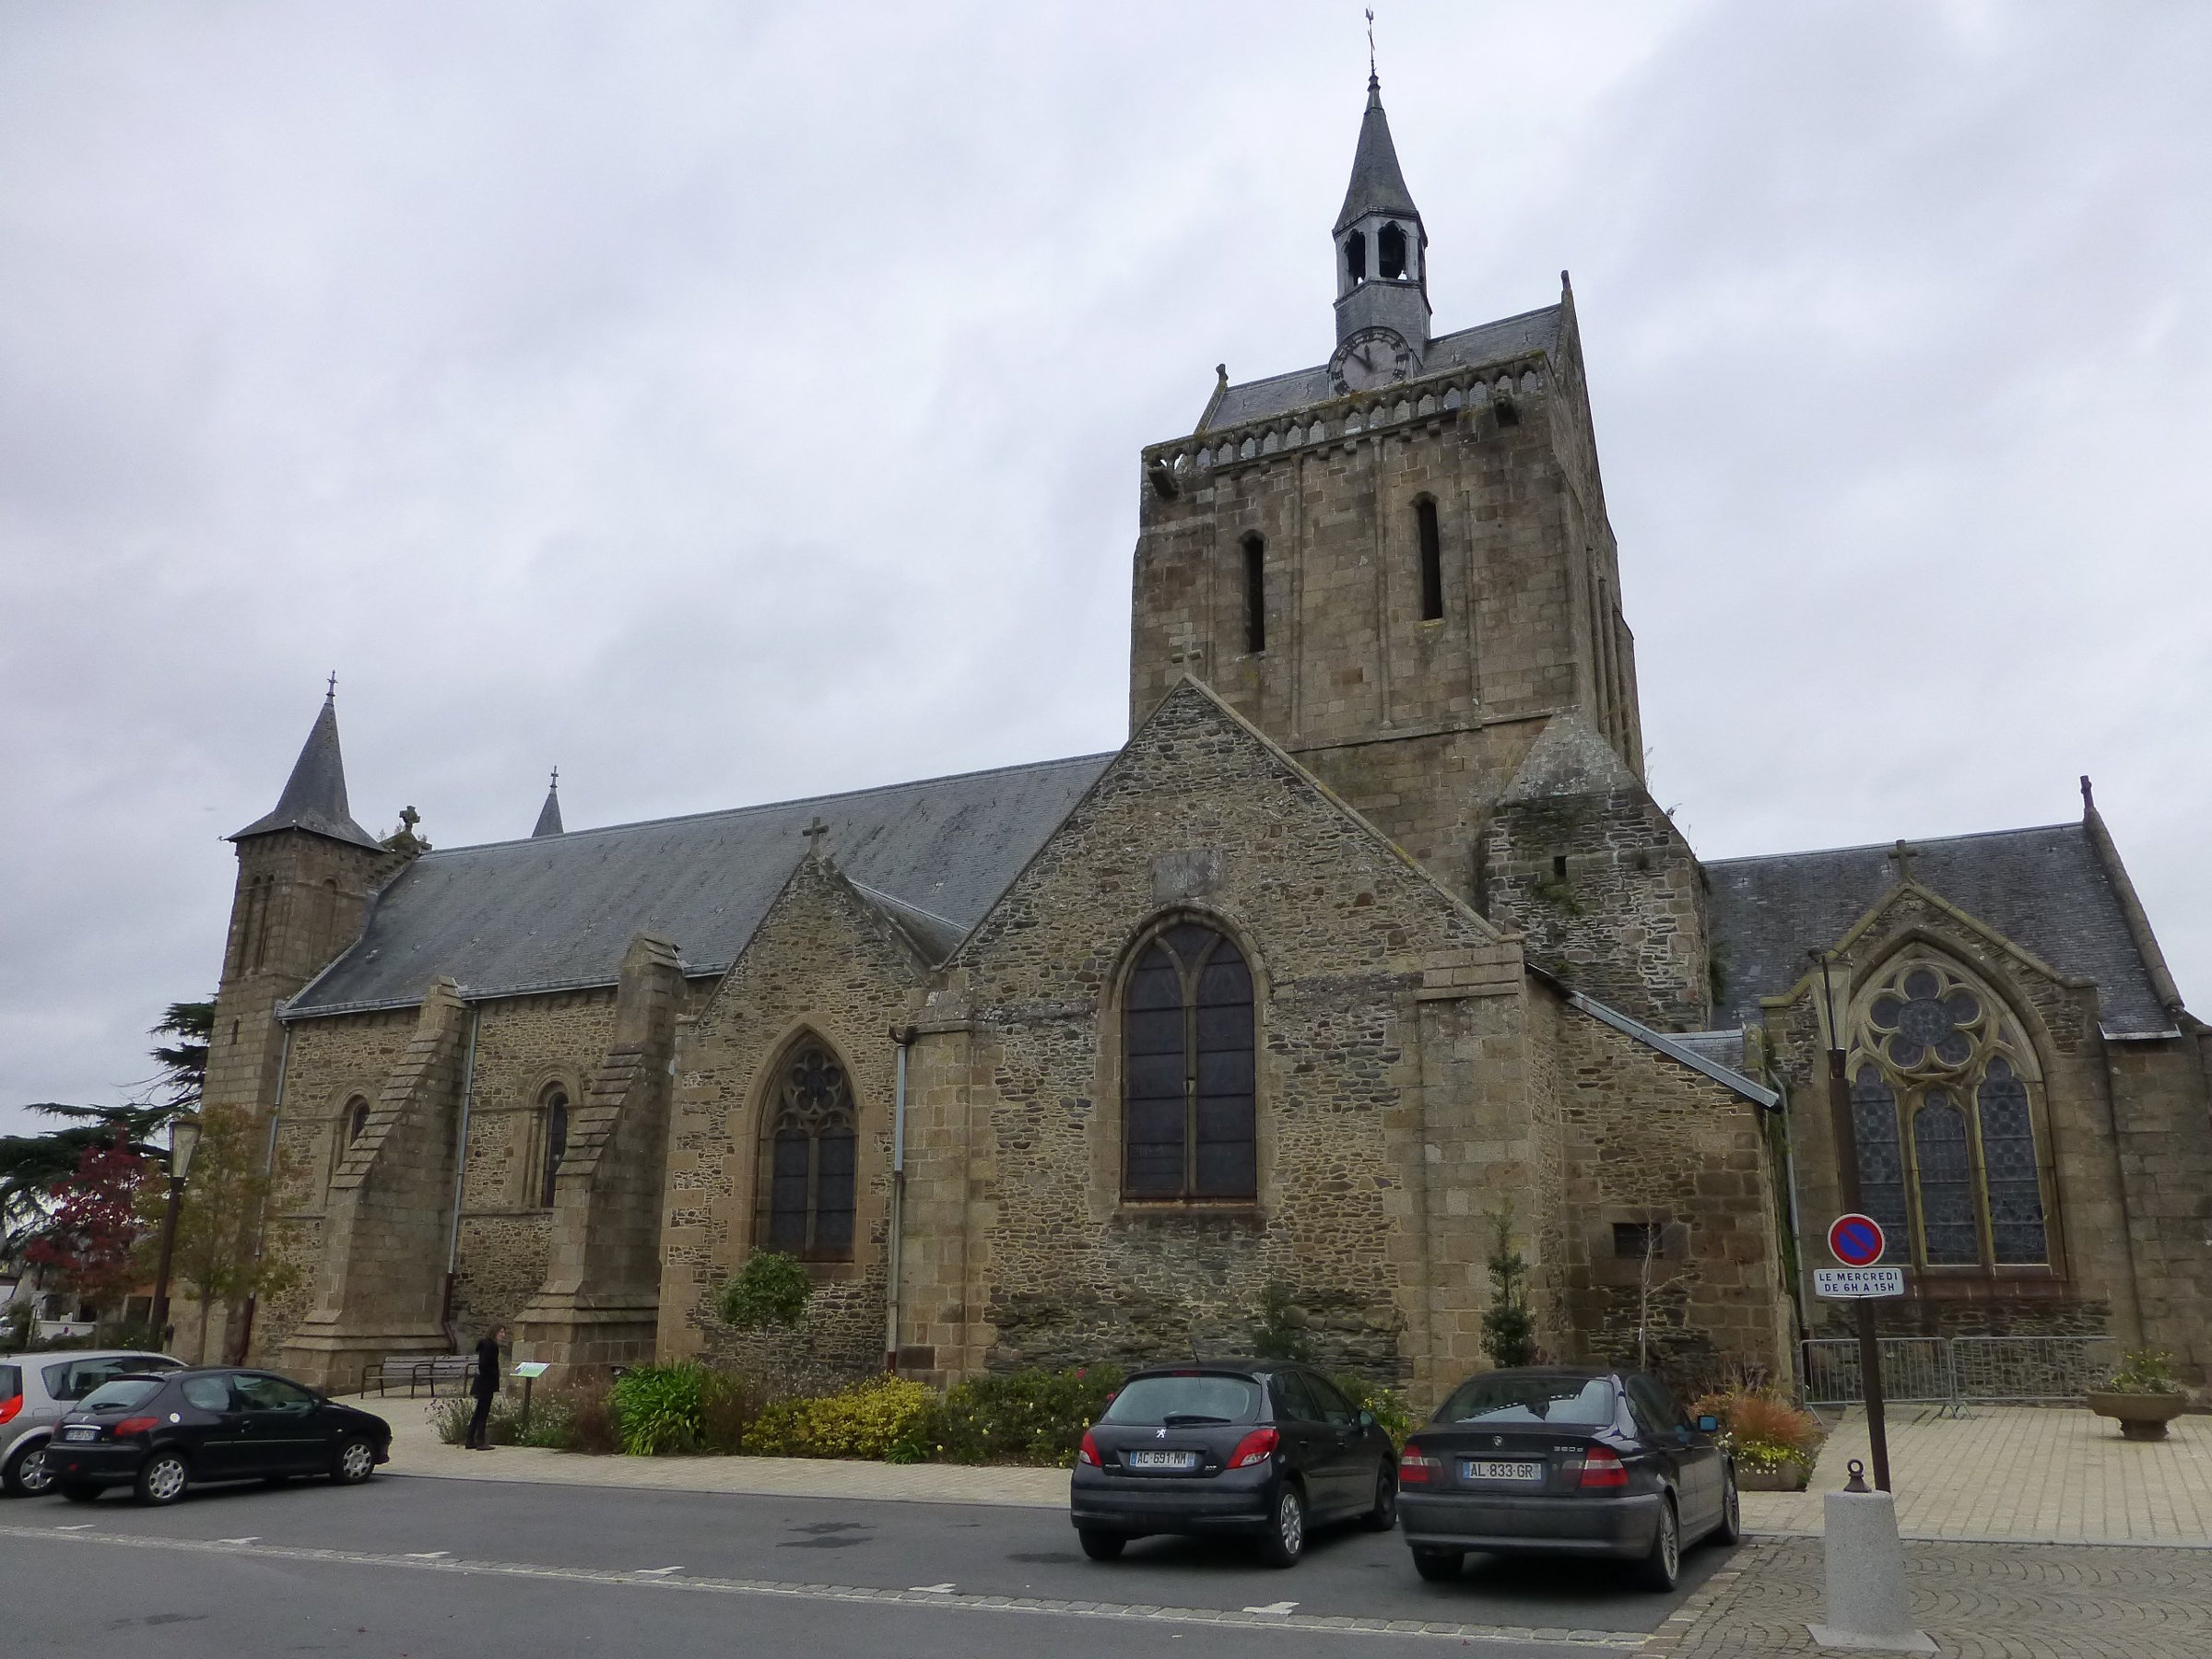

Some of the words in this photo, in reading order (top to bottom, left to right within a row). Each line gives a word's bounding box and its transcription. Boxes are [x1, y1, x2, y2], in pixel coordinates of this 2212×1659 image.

[1818, 1273, 1832, 1281] LE
[1837, 1272, 1898, 1281] MERCREDI
[1824, 1283, 1839, 1292] DE
[1843, 1283, 1858, 1291] 6H
[1863, 1283, 1870, 1291] A
[1874, 1283, 1895, 1291] 15H
